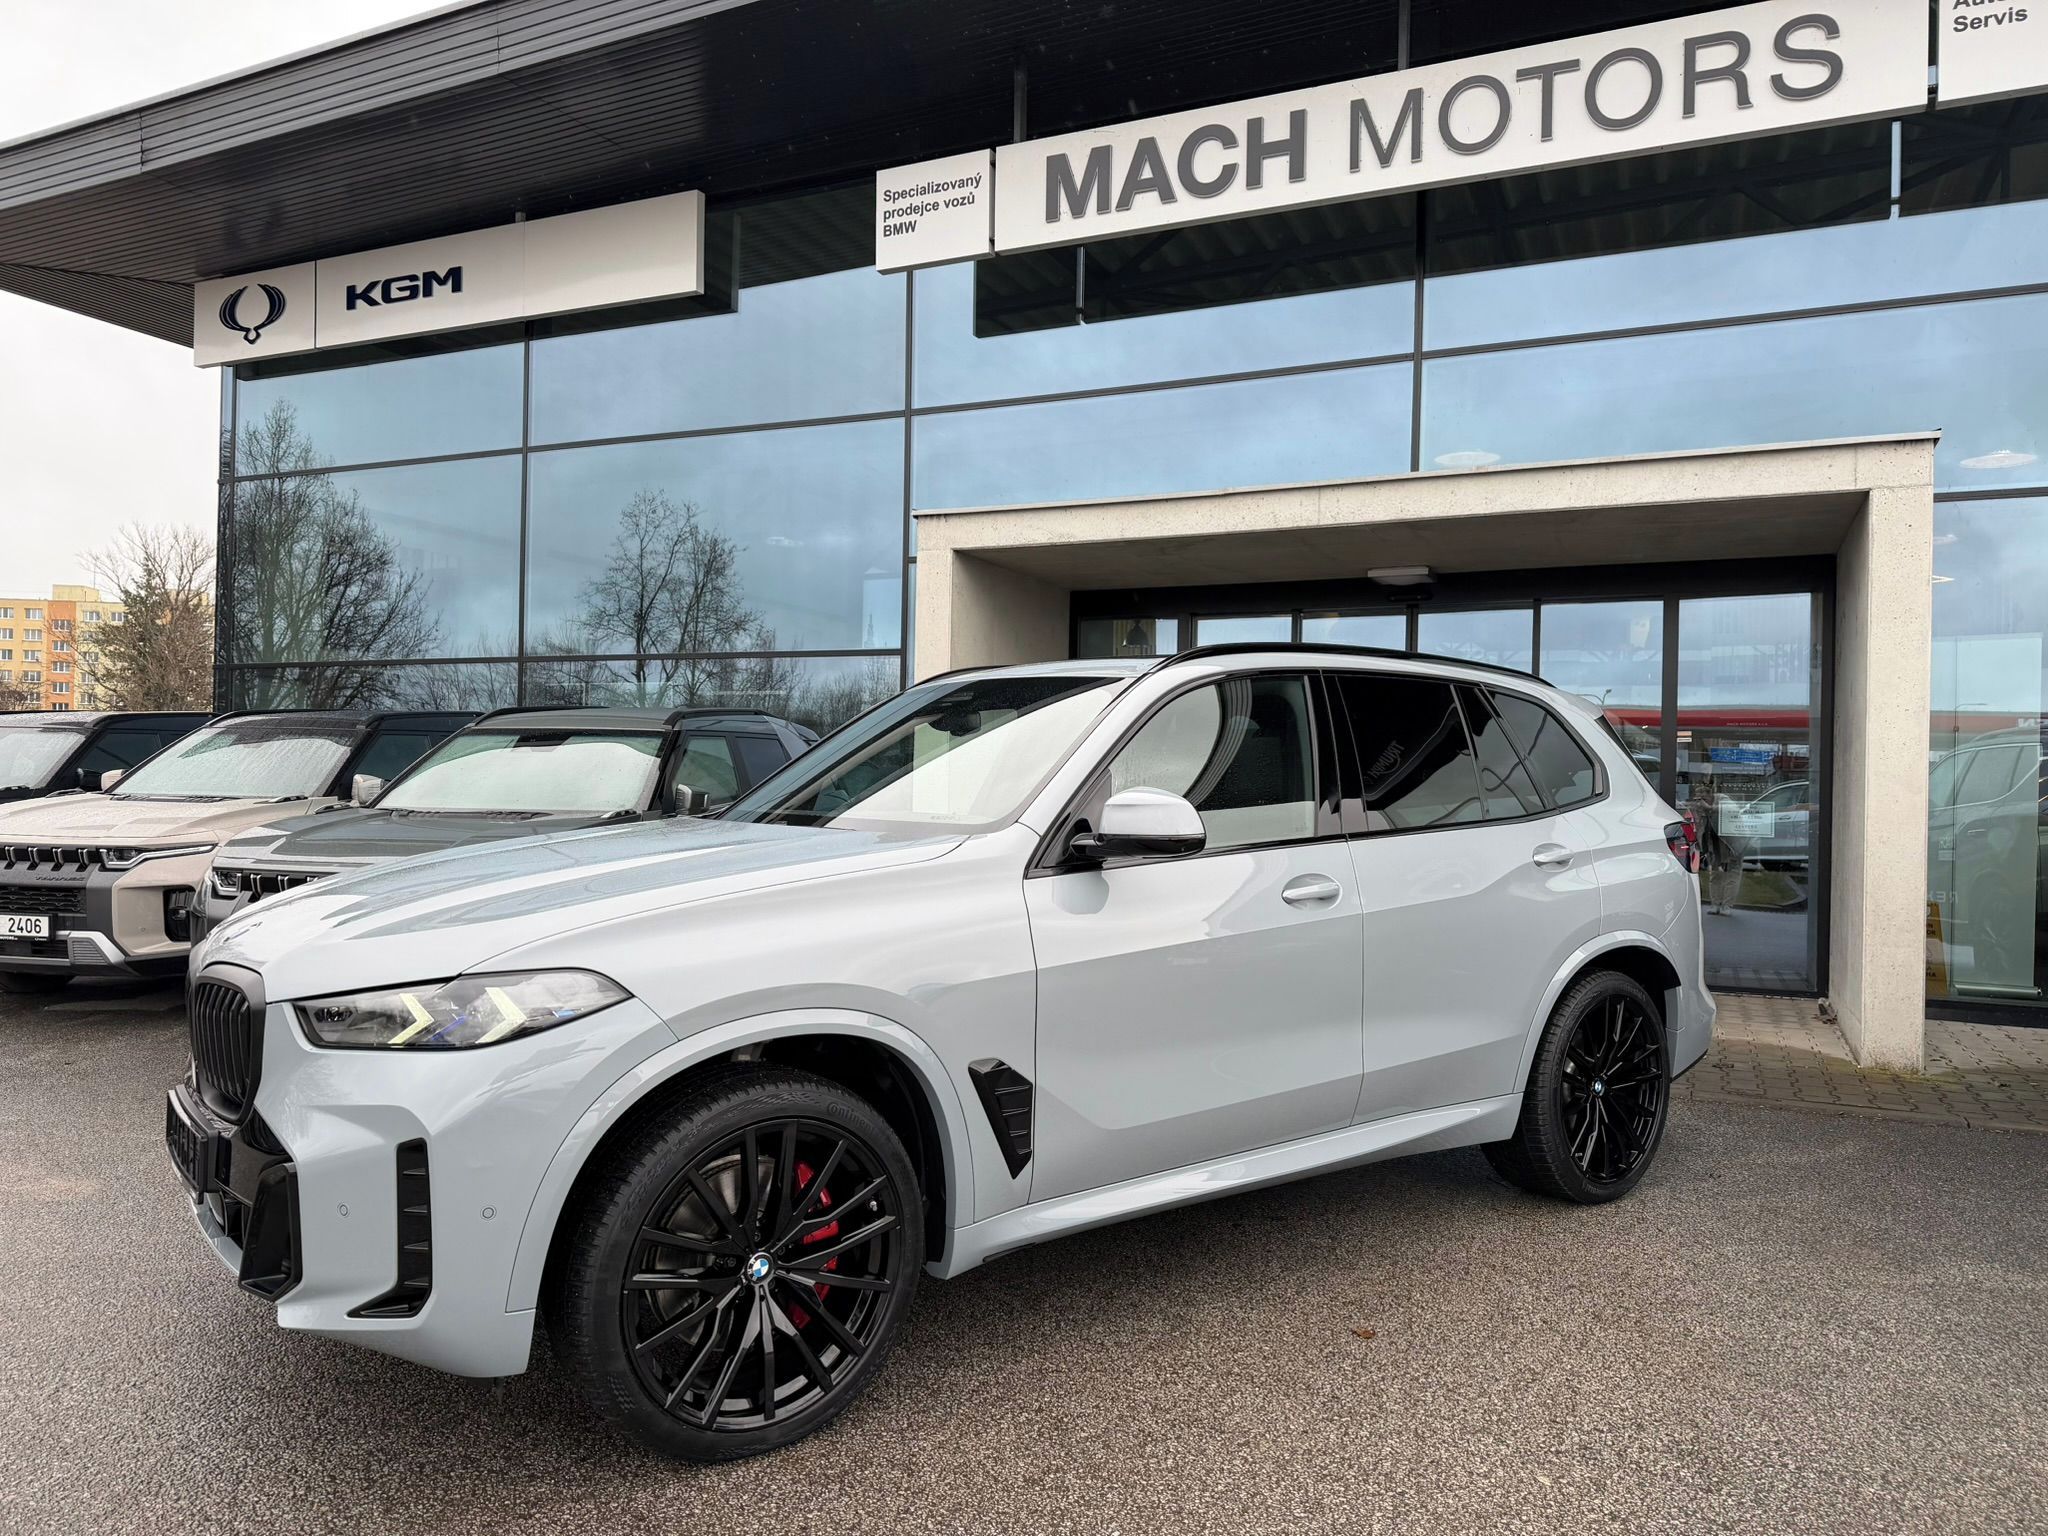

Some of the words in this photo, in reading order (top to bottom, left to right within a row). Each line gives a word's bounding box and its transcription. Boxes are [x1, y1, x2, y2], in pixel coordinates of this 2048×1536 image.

[1952, 7, 2028, 32] Servis
[1044, 108, 1308, 224] MACH
[1349, 12, 1844, 173] MOTORS
[883, 172, 982, 204] Specializovaný
[883, 200, 940, 223] prodejce
[943, 191, 975, 209] vozů
[883, 220, 917, 238] BMW
[345, 265, 463, 311] KGM
[8, 917, 42, 934] 2406
